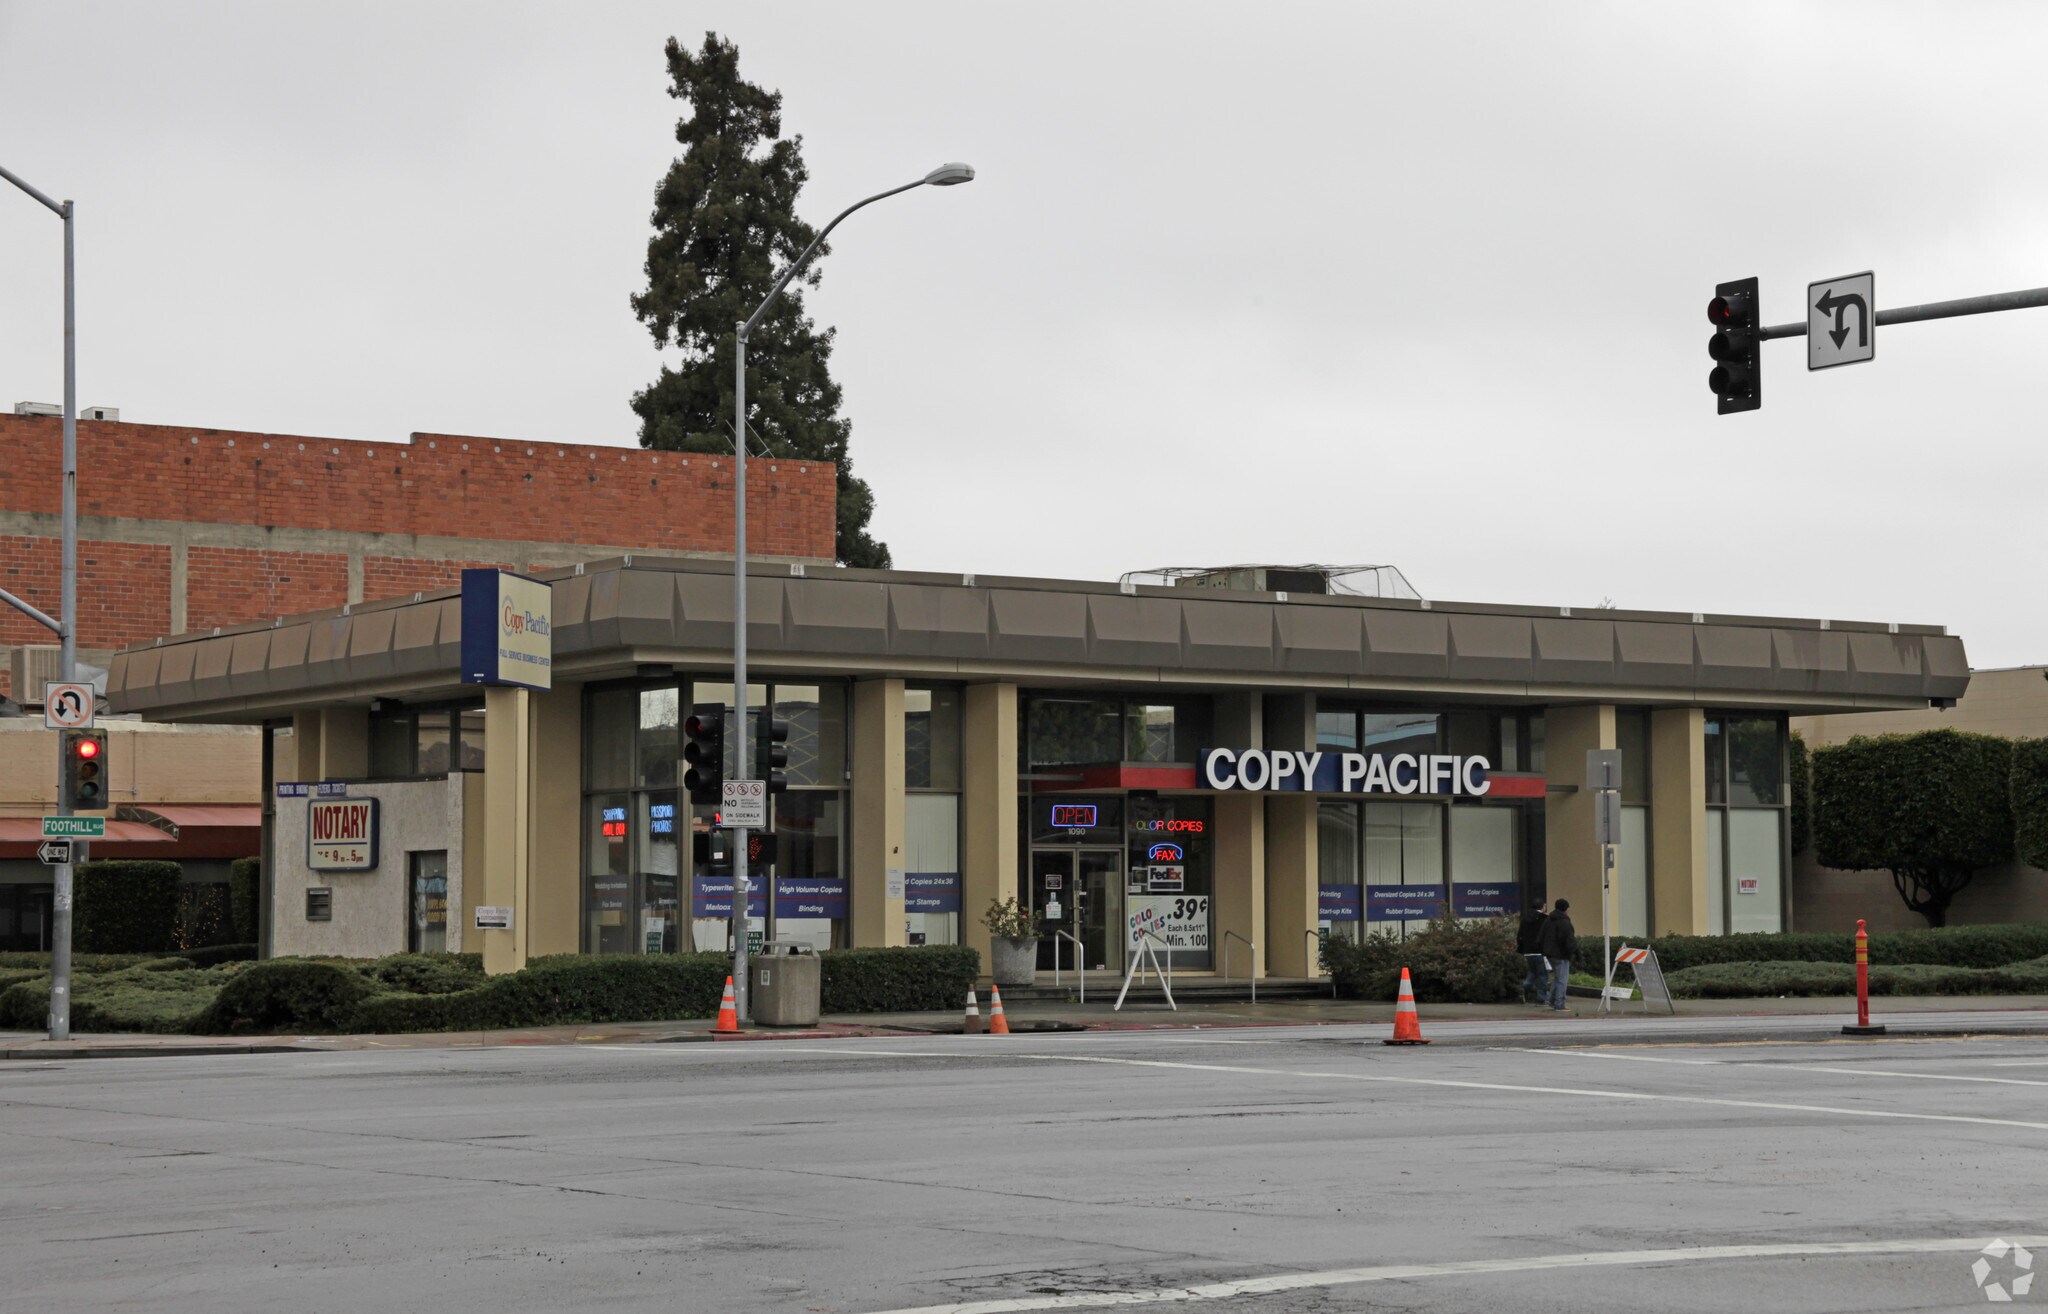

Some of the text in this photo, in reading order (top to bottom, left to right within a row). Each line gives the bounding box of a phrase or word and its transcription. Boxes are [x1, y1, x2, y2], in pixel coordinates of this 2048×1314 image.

[504, 606, 549, 636] Copy Pacific
[509, 652, 522, 661] SERVICE
[523, 654, 538, 664] BUSINESS
[539, 656, 550, 666] CENTER
[1206, 748, 1490, 796] COPY PACIFIC
[724, 799, 737, 807] NO
[604, 808, 624, 821] SHIPPING
[651, 805, 672, 818] PASSPORT
[1054, 808, 1094, 824] OPEN
[44, 821, 92, 832] FOOTHILL
[313, 806, 368, 839] NOTARY
[651, 820, 672, 833] PHOTOS
[1167, 820, 1203, 832] COPIES
[1156, 850, 1176, 860] FAX
[1150, 868, 1182, 880] FedEx
[798, 905, 824, 914] Binding
[1133, 916, 1165, 942] COIES
[1166, 935, 1206, 946] Min. 100
